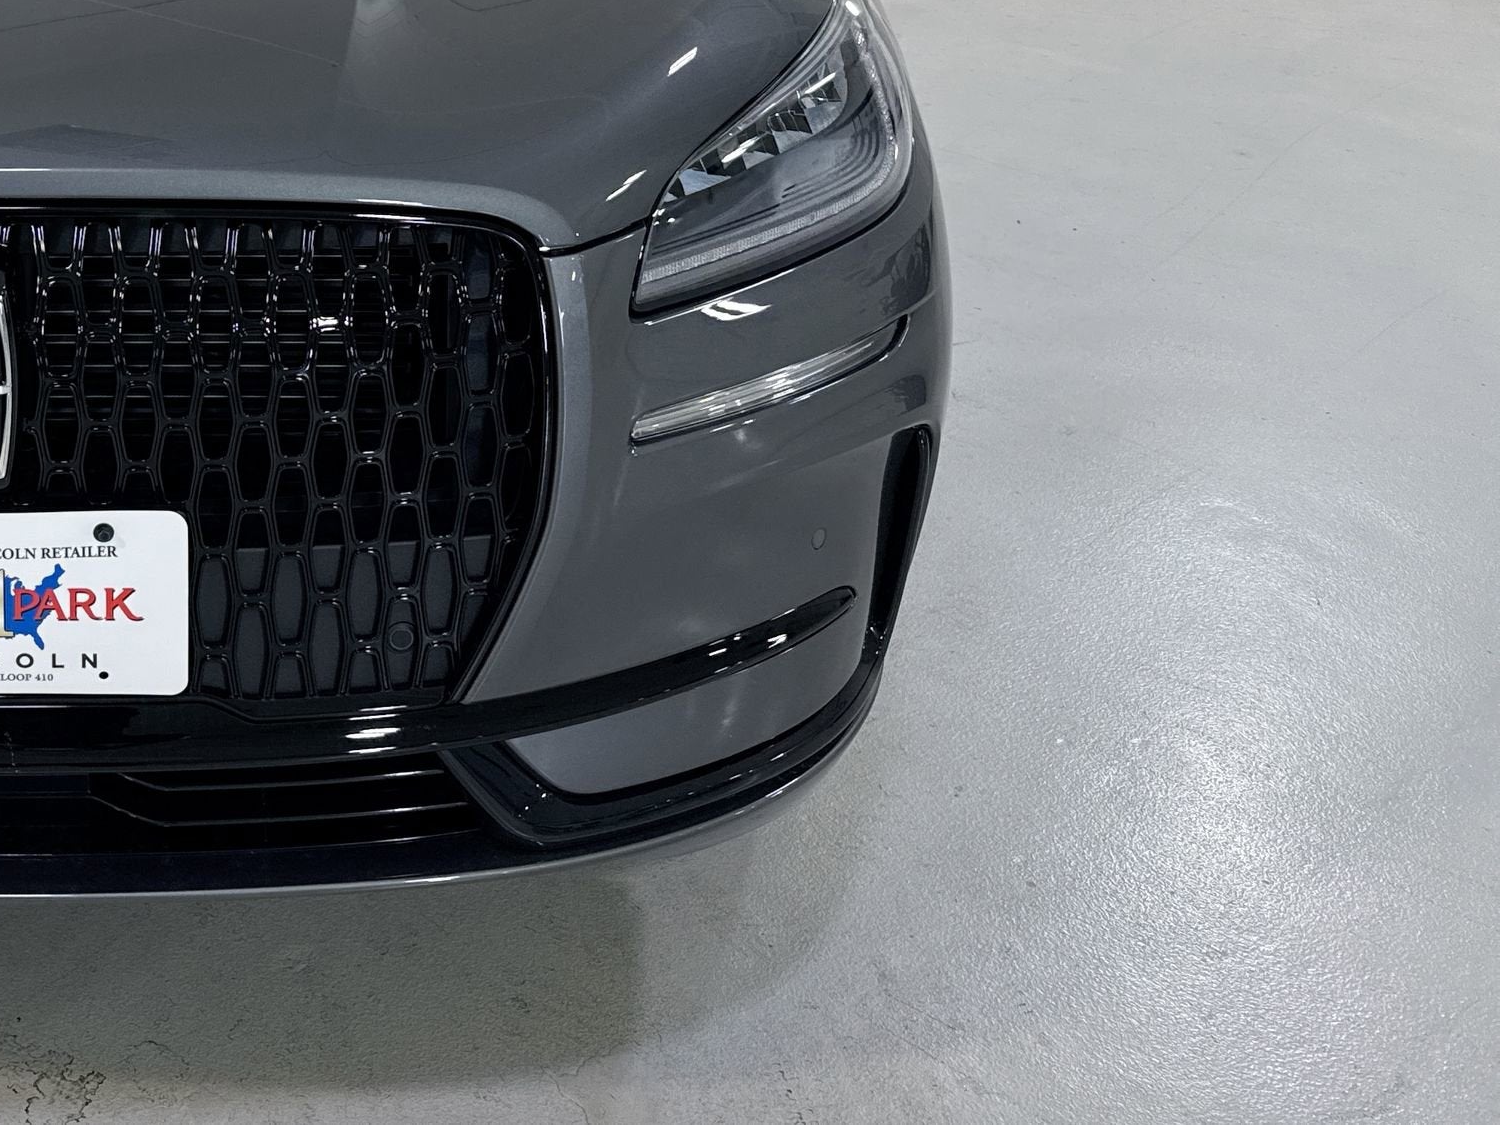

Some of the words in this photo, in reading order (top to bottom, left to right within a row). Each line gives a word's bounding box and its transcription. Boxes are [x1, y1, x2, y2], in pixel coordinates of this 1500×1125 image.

[40, 545, 118, 559] RETAILER
[11, 587, 145, 623] PARK
[0, 673, 32, 682] LOOP
[34, 672, 55, 682] 410
